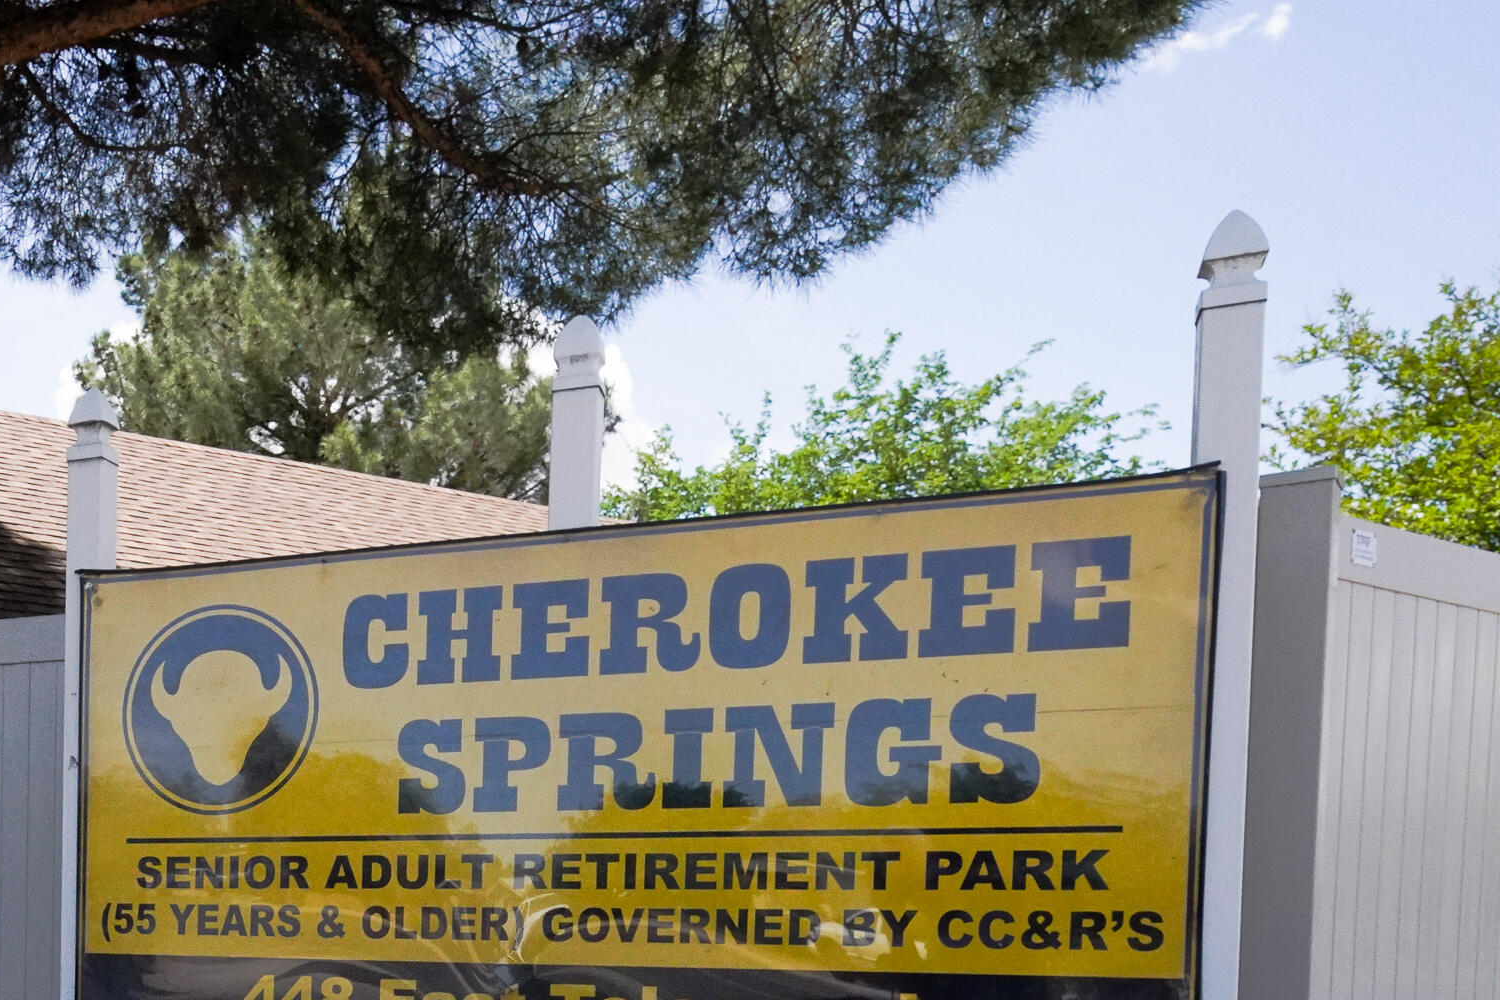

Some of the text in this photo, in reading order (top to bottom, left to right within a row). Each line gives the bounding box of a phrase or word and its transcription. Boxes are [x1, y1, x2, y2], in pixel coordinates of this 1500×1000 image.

[343, 535, 1131, 690] CHEROKEE
[398, 693, 1041, 814] SPRINGS
[137, 849, 1110, 891] SENIOR ADULT RETIREMENT PARK
[102, 902, 1165, 953] (55 YEARS & OLDER) GOVERNED BY CC&R'S
